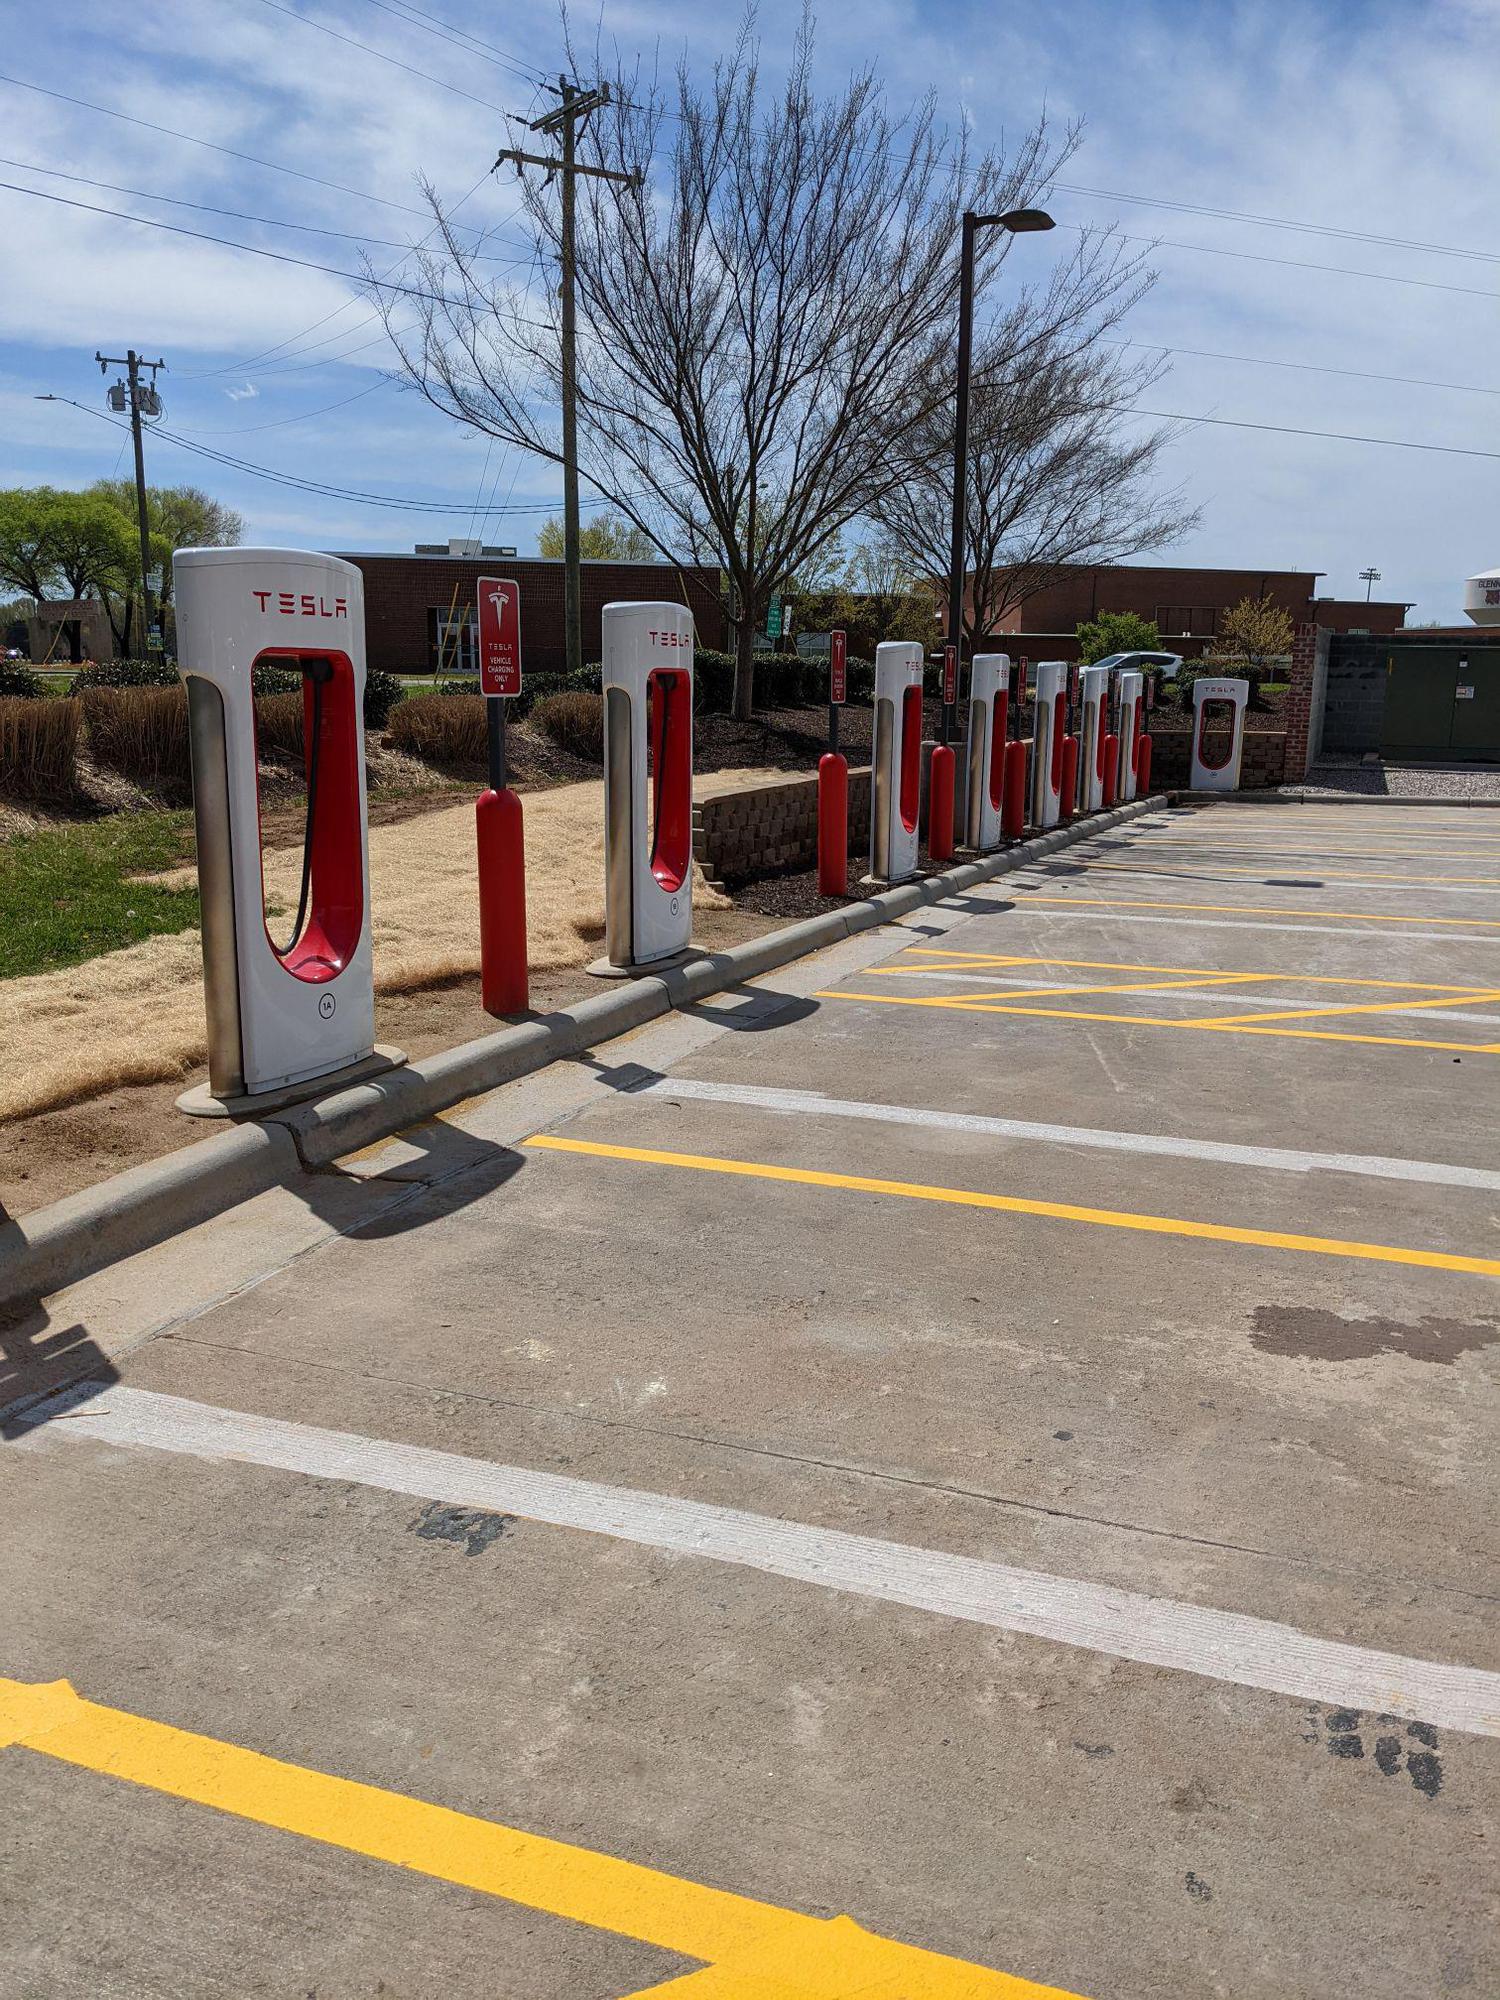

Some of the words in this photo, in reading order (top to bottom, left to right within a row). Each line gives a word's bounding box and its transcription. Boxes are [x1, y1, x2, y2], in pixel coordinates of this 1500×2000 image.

[252, 591, 347, 619] TESLA
[649, 631, 690, 648] TESLA
[488, 643, 513, 651] TESLA
[490, 656, 511, 665] VEHICLE
[487, 665, 515, 674] CHARGING
[494, 674, 509, 683] ONLY
